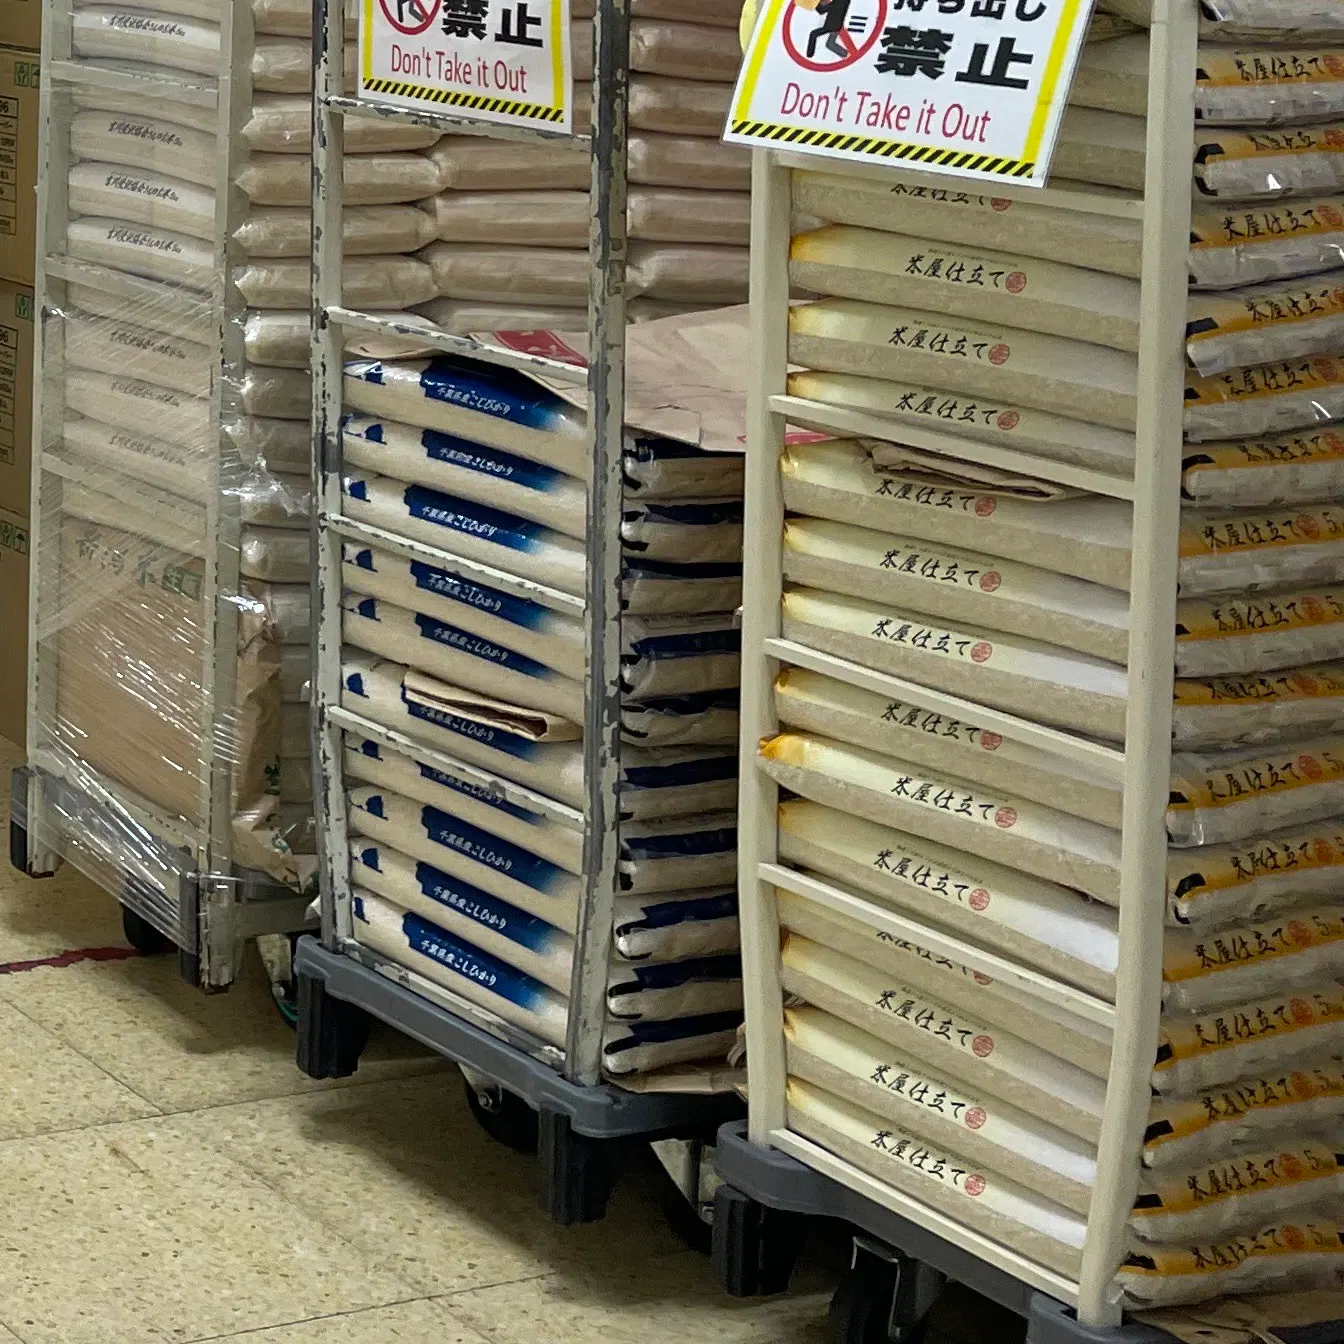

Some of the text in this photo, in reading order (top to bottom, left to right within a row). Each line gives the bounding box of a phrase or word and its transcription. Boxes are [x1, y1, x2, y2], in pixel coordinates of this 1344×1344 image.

[391, 44, 527, 93] Don't Take it Out
[872, 25, 1036, 91] 禁止
[781, 82, 992, 144] Don't Take it Out
[905, 254, 1004, 290] 米屋仕立て
[889, 326, 989, 361] 米屋仕立て
[895, 392, 997, 427] 米屋仕立て
[879, 549, 979, 589] 米屋仕立て
[871, 619, 971, 658] 米屋仕立て
[880, 701, 982, 743] 米屋仕立て
[890, 775, 995, 821] 米屋仕立て
[872, 847, 970, 902] 米屋仕立て
[875, 988, 973, 1048] 米屋仕立て
[870, 1062, 965, 1119] 米屋仕立て
[871, 1128, 966, 1186] 米屋仕立て
